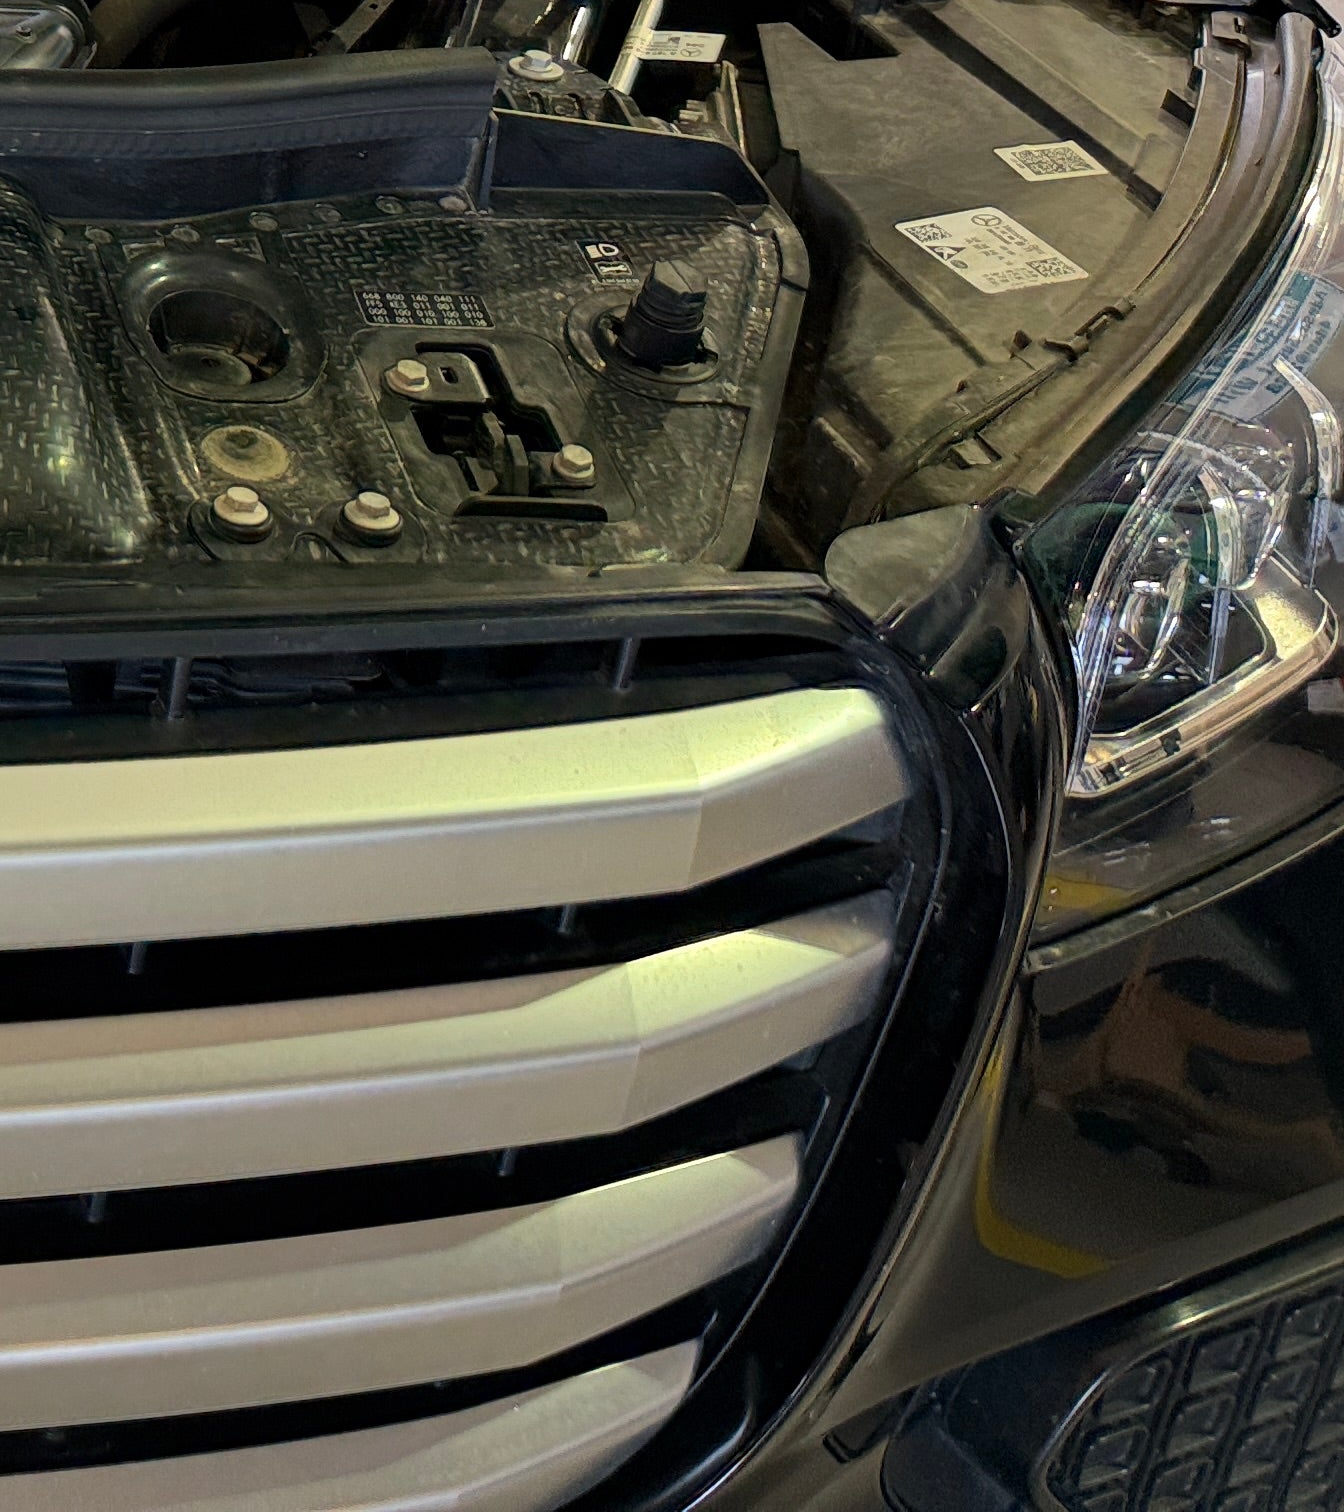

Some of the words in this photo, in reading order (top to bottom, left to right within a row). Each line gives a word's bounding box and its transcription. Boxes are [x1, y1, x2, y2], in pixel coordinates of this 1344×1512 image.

[386, 293, 404, 301] 800
[411, 294, 428, 303] 140
[434, 294, 453, 303] 040
[459, 295, 476, 303] 111
[413, 301, 431, 310] 011
[437, 302, 455, 310] 001
[461, 303, 479, 311] 011
[368, 307, 387, 316] 000
[394, 308, 411, 317] 100
[416, 309, 435, 317] 010
[442, 310, 459, 318] 100
[464, 310, 483, 319] 010
[373, 315, 390, 324] 101
[395, 316, 413, 324] 001
[421, 317, 438, 325] 101
[444, 318, 462, 326] 001
